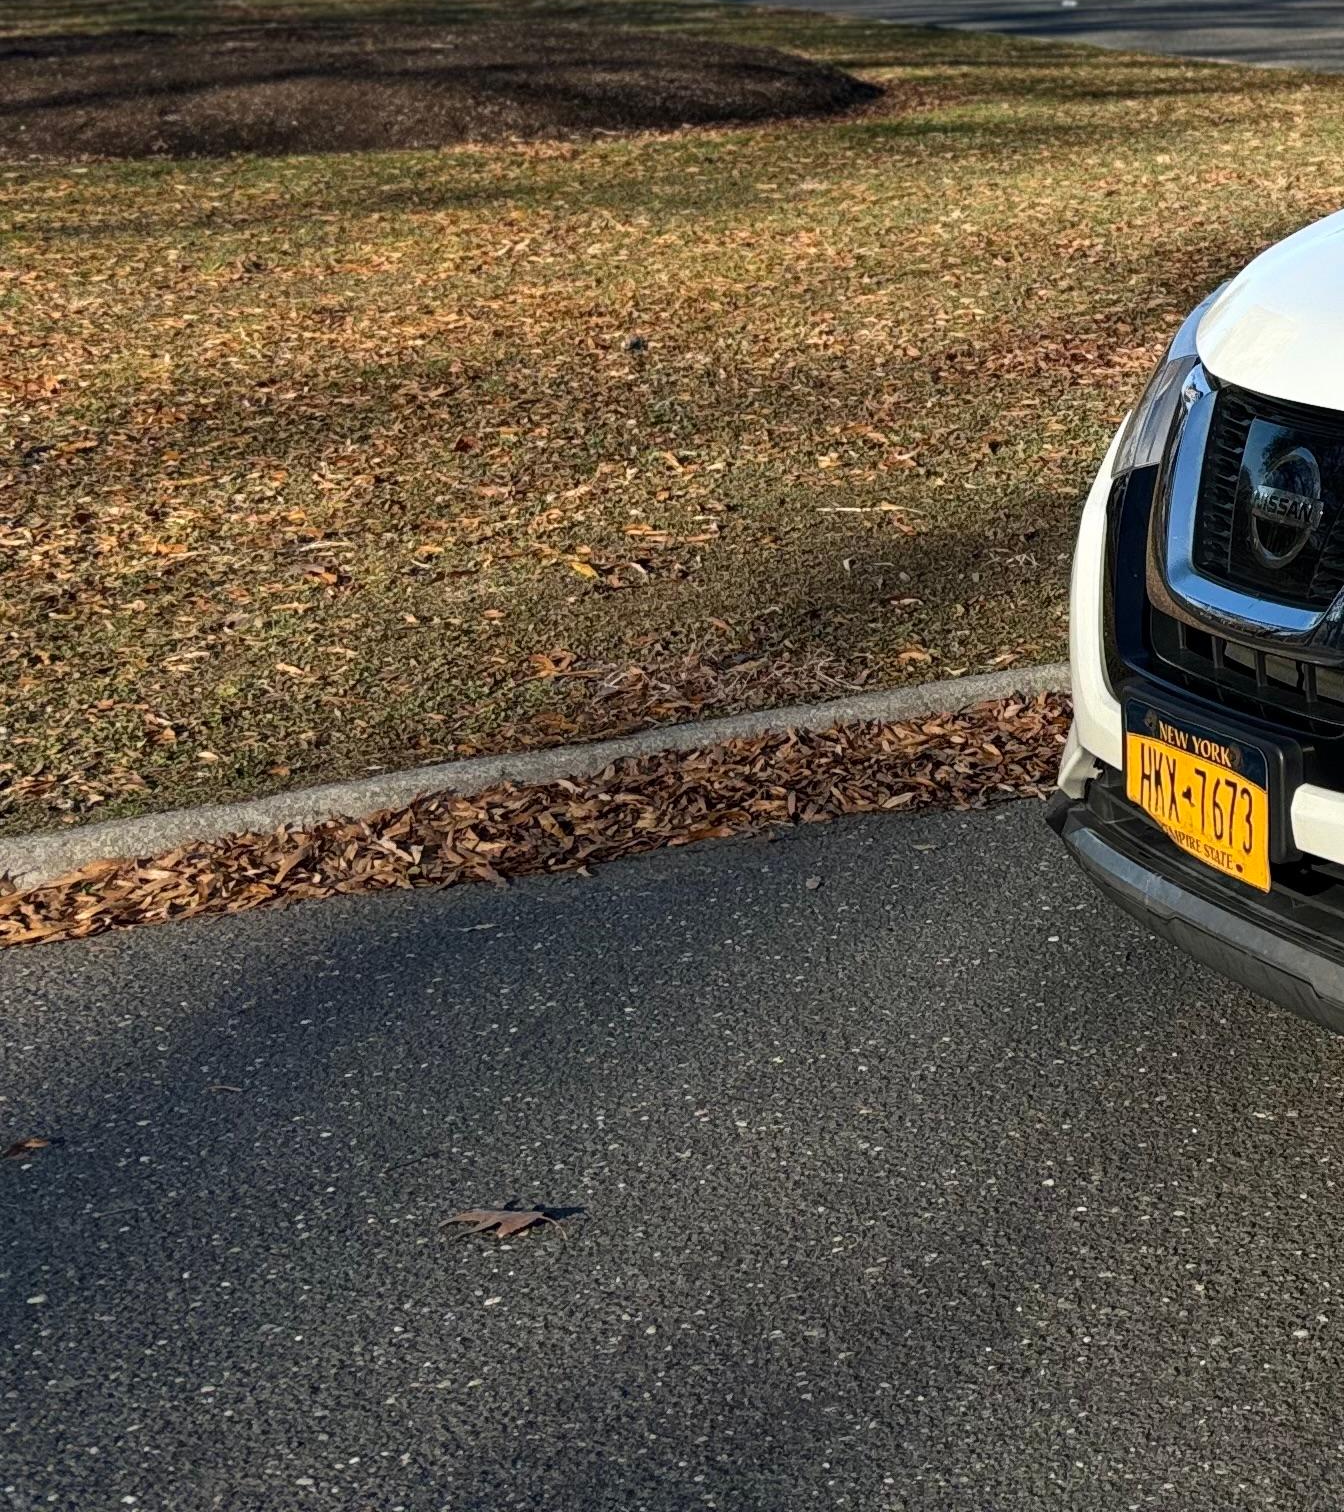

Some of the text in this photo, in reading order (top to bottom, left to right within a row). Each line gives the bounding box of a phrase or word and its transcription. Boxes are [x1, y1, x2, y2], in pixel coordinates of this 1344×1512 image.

[1255, 491, 1312, 523] NISSAN
[1158, 720, 1233, 768] NEW YORK
[1203, 843, 1234, 870] STATE
